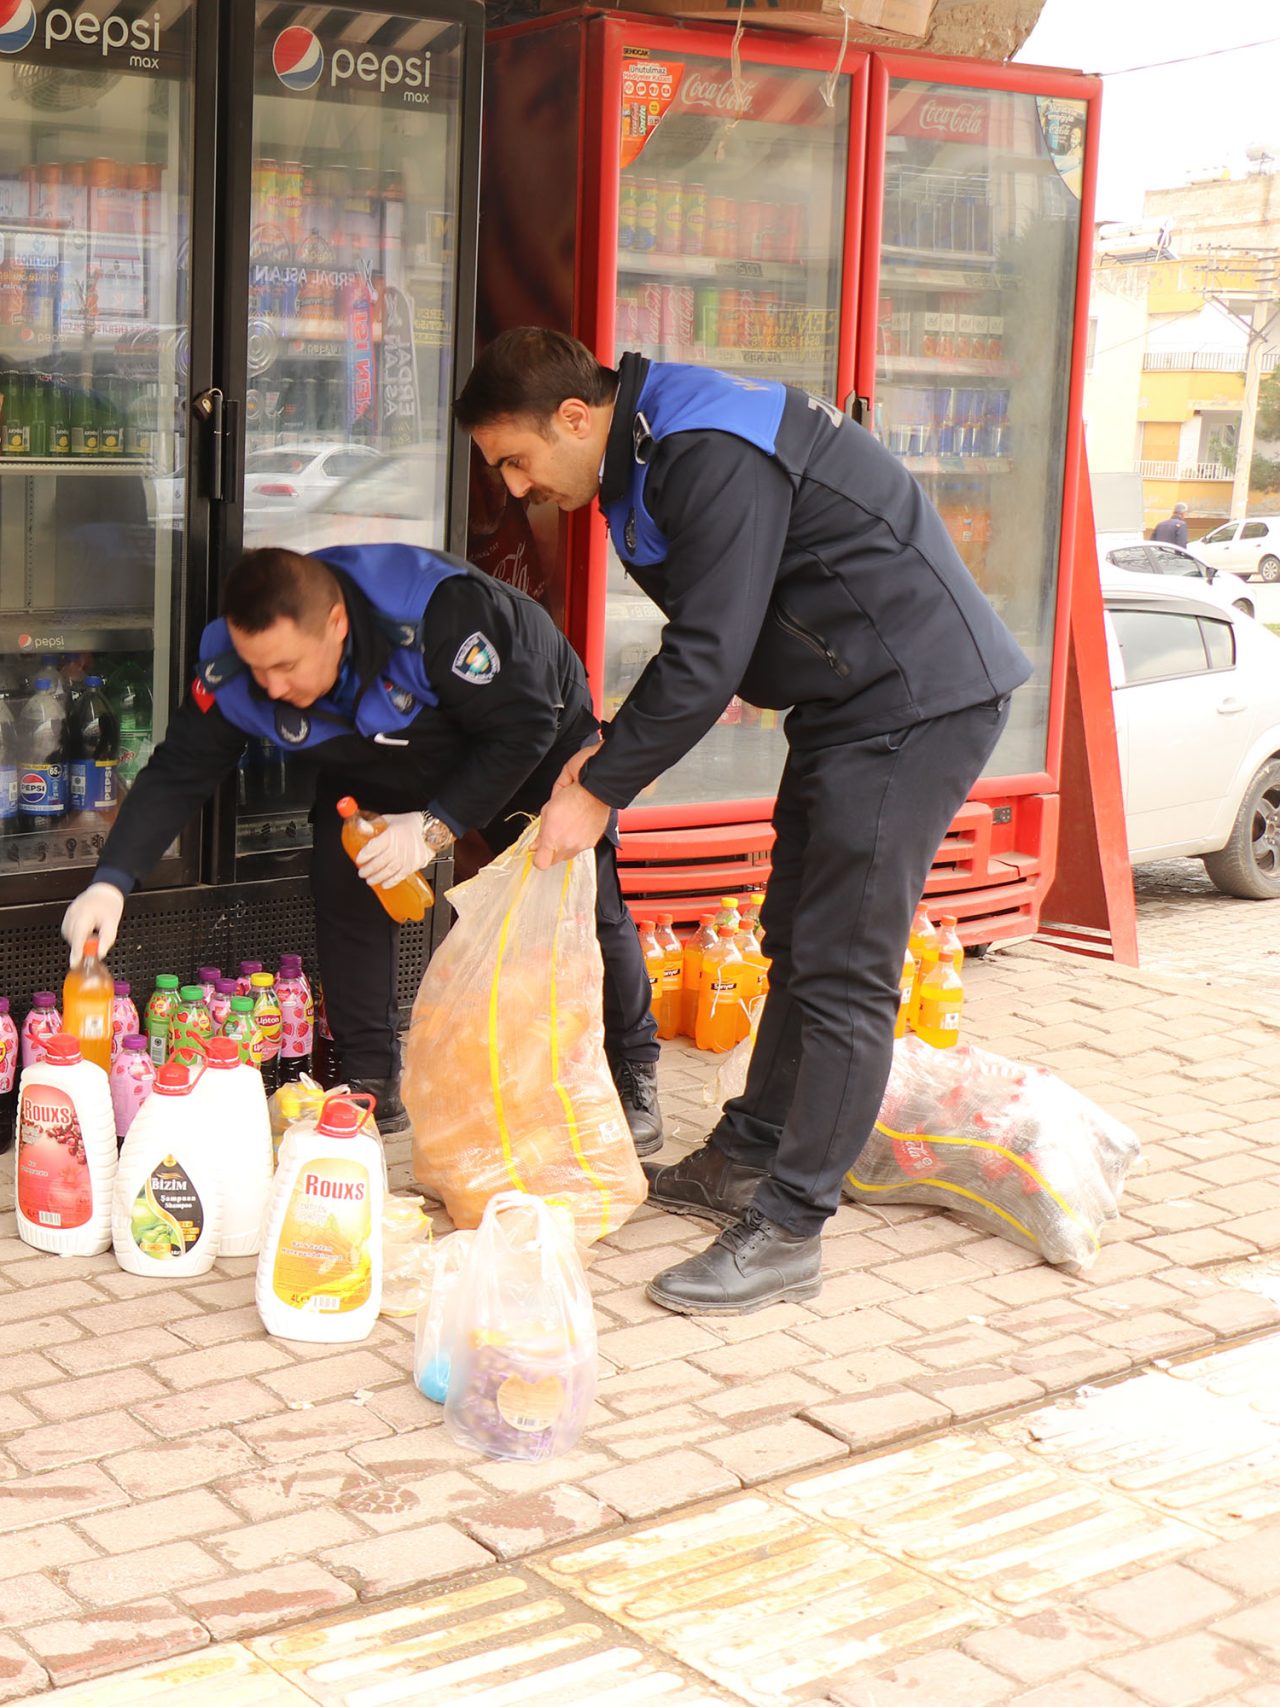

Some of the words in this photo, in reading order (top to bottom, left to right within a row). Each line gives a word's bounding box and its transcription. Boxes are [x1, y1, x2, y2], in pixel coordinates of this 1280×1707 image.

[45, 9, 160, 56] pepsi
[129, 56, 159, 69] max
[331, 48, 431, 92] pepsi
[404, 91, 429, 104] max
[35, 636, 64, 648] pepsi
[21, 785, 45, 793] PEPSI
[256, 1015, 281, 1026] Lipton
[152, 1177, 187, 1191] BİZİM
